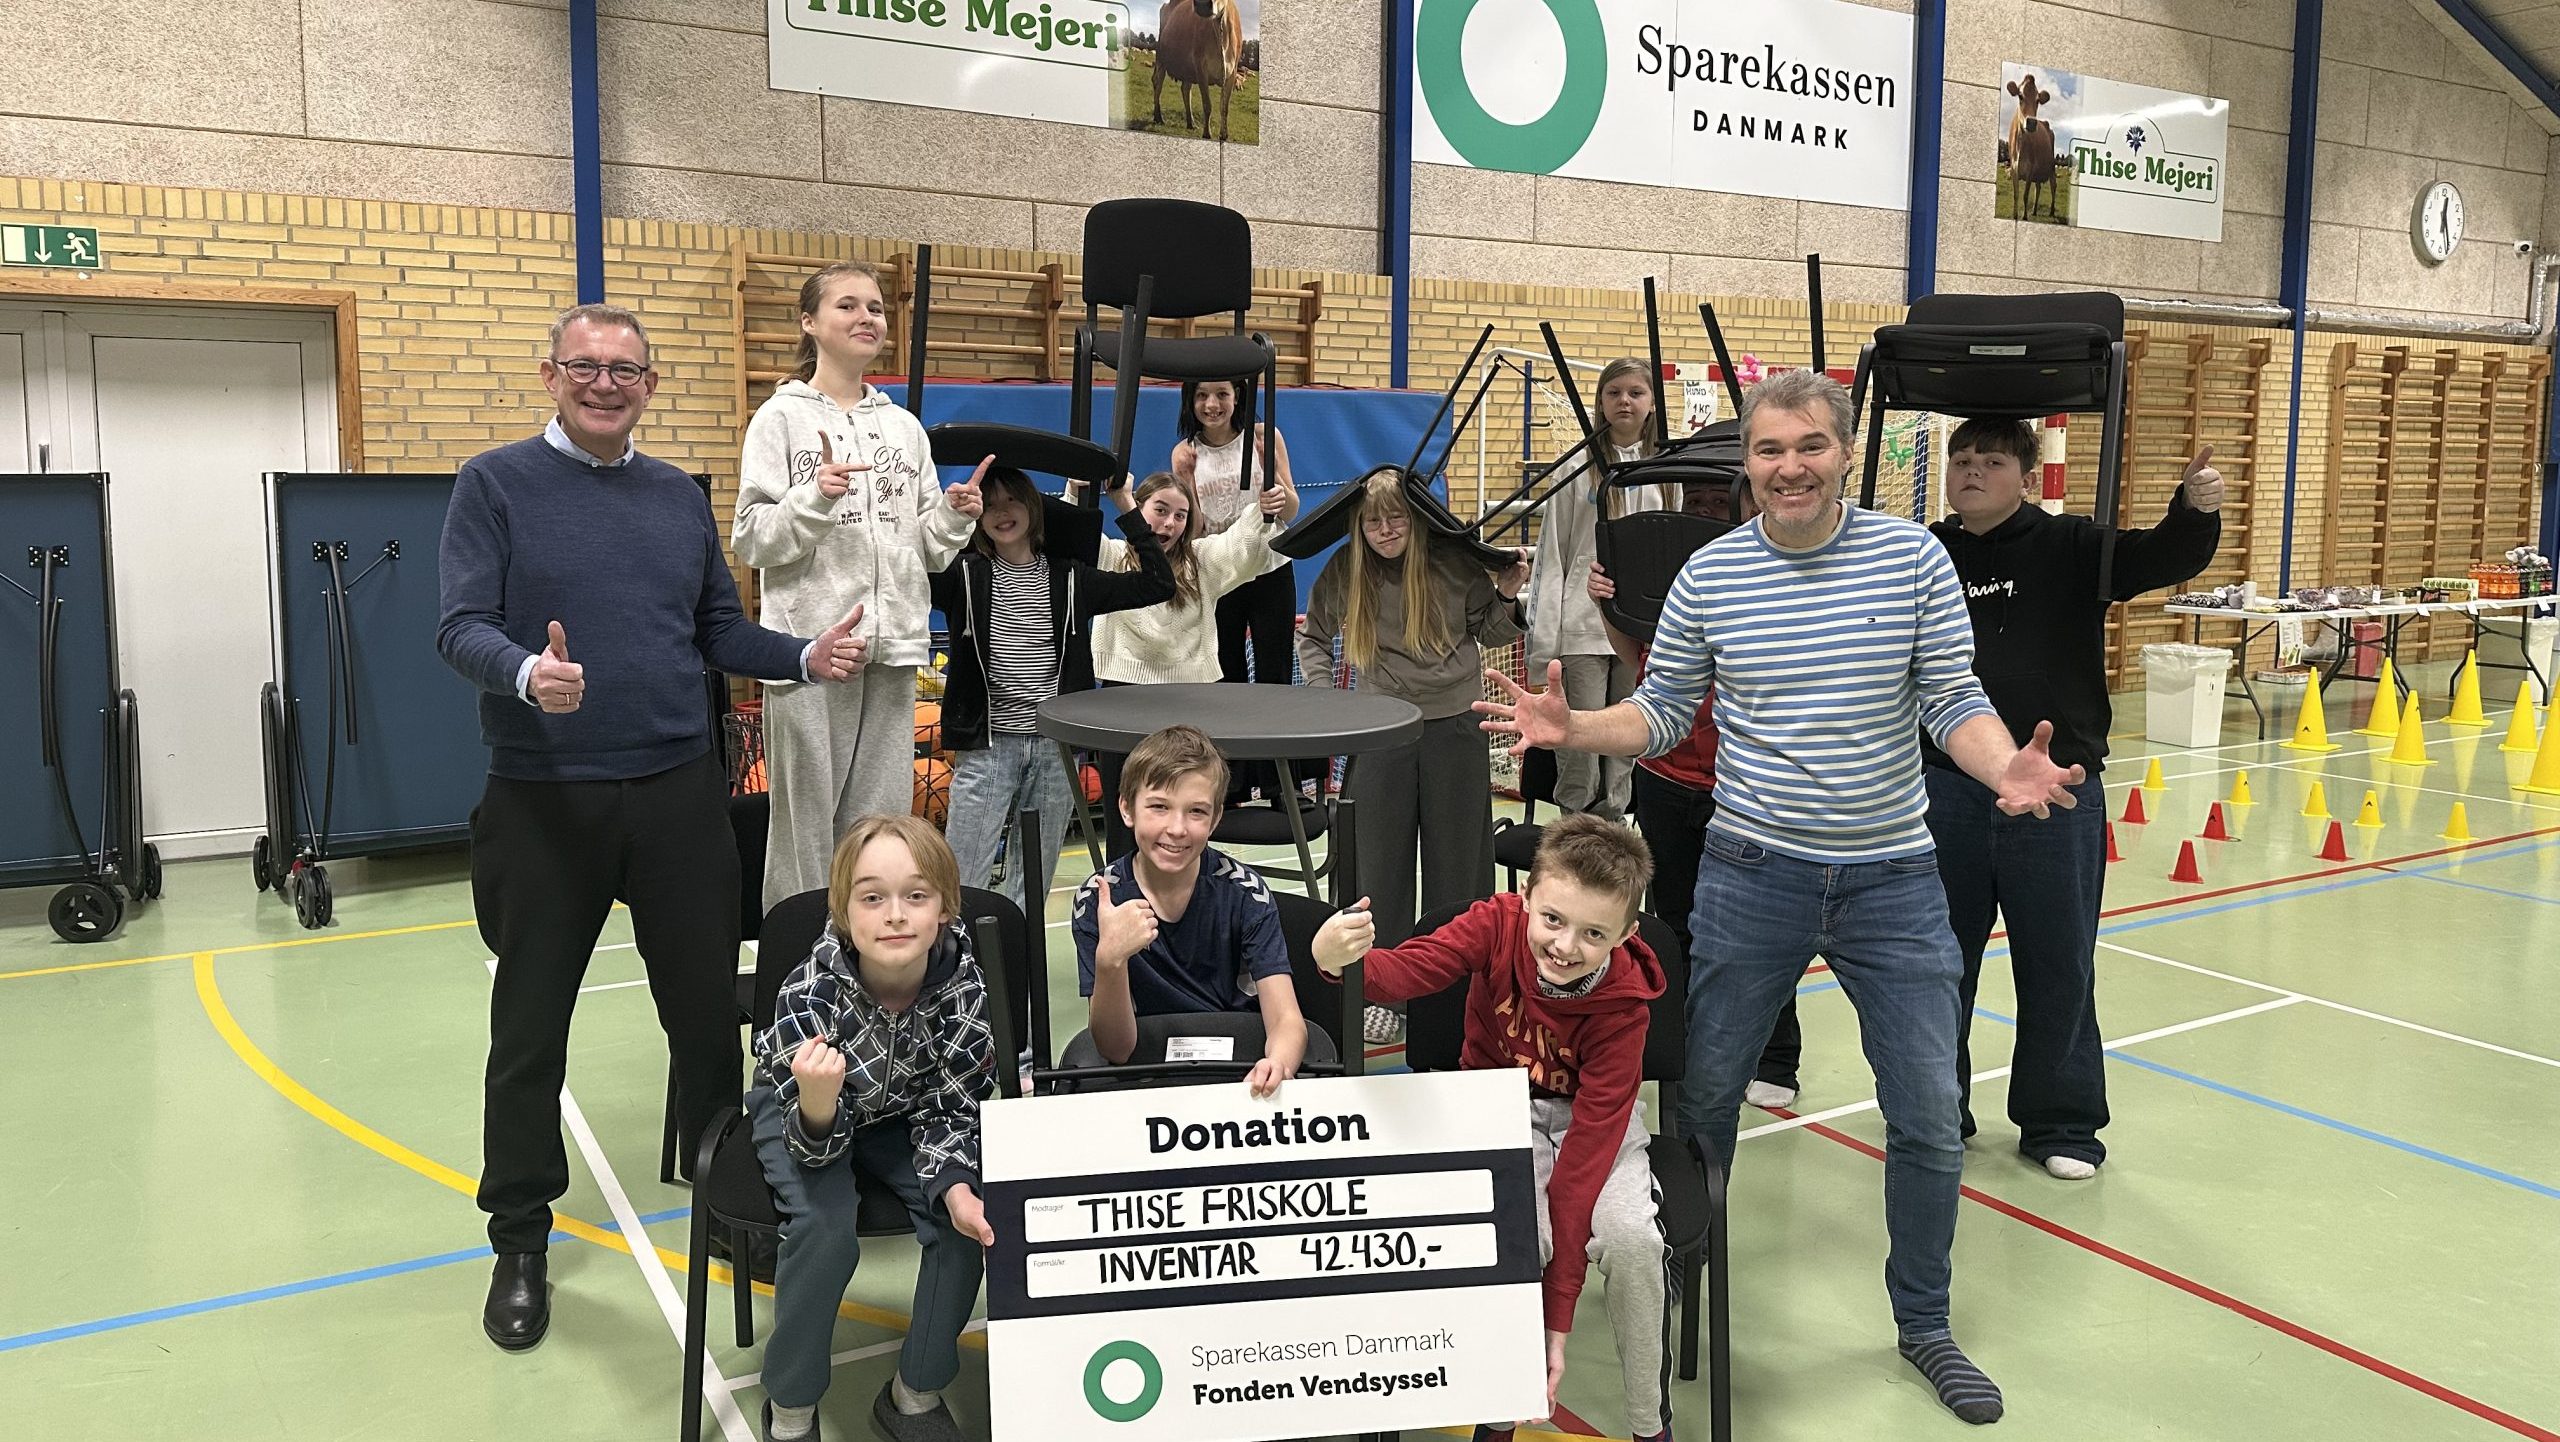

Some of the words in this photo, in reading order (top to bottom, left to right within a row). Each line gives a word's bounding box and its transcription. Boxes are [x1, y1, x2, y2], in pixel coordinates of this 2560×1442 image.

[965, 0, 1119, 51] Mejeri
[1637, 24, 1895, 108] Sparekassen
[1693, 109, 1848, 150] DANMARK
[2074, 146, 2137, 180] Thise
[2144, 156, 2213, 193] Mejeri
[868, 432, 880, 440] 95
[1145, 1107, 1370, 1154] Donation
[1031, 1204, 1064, 1213] Modtager
[1077, 1191, 1186, 1235] THISE
[1202, 1178, 1368, 1225] FRISKOLE
[1099, 1242, 1260, 1285] INVENTAR
[1300, 1231, 1443, 1272] 42.430,-
[1191, 1339, 1339, 1372] Sparekassen
[1345, 1327, 1455, 1356] Danmark
[1192, 1379, 1295, 1406] Fonden
[1299, 1366, 1448, 1397] Vendsyssel
